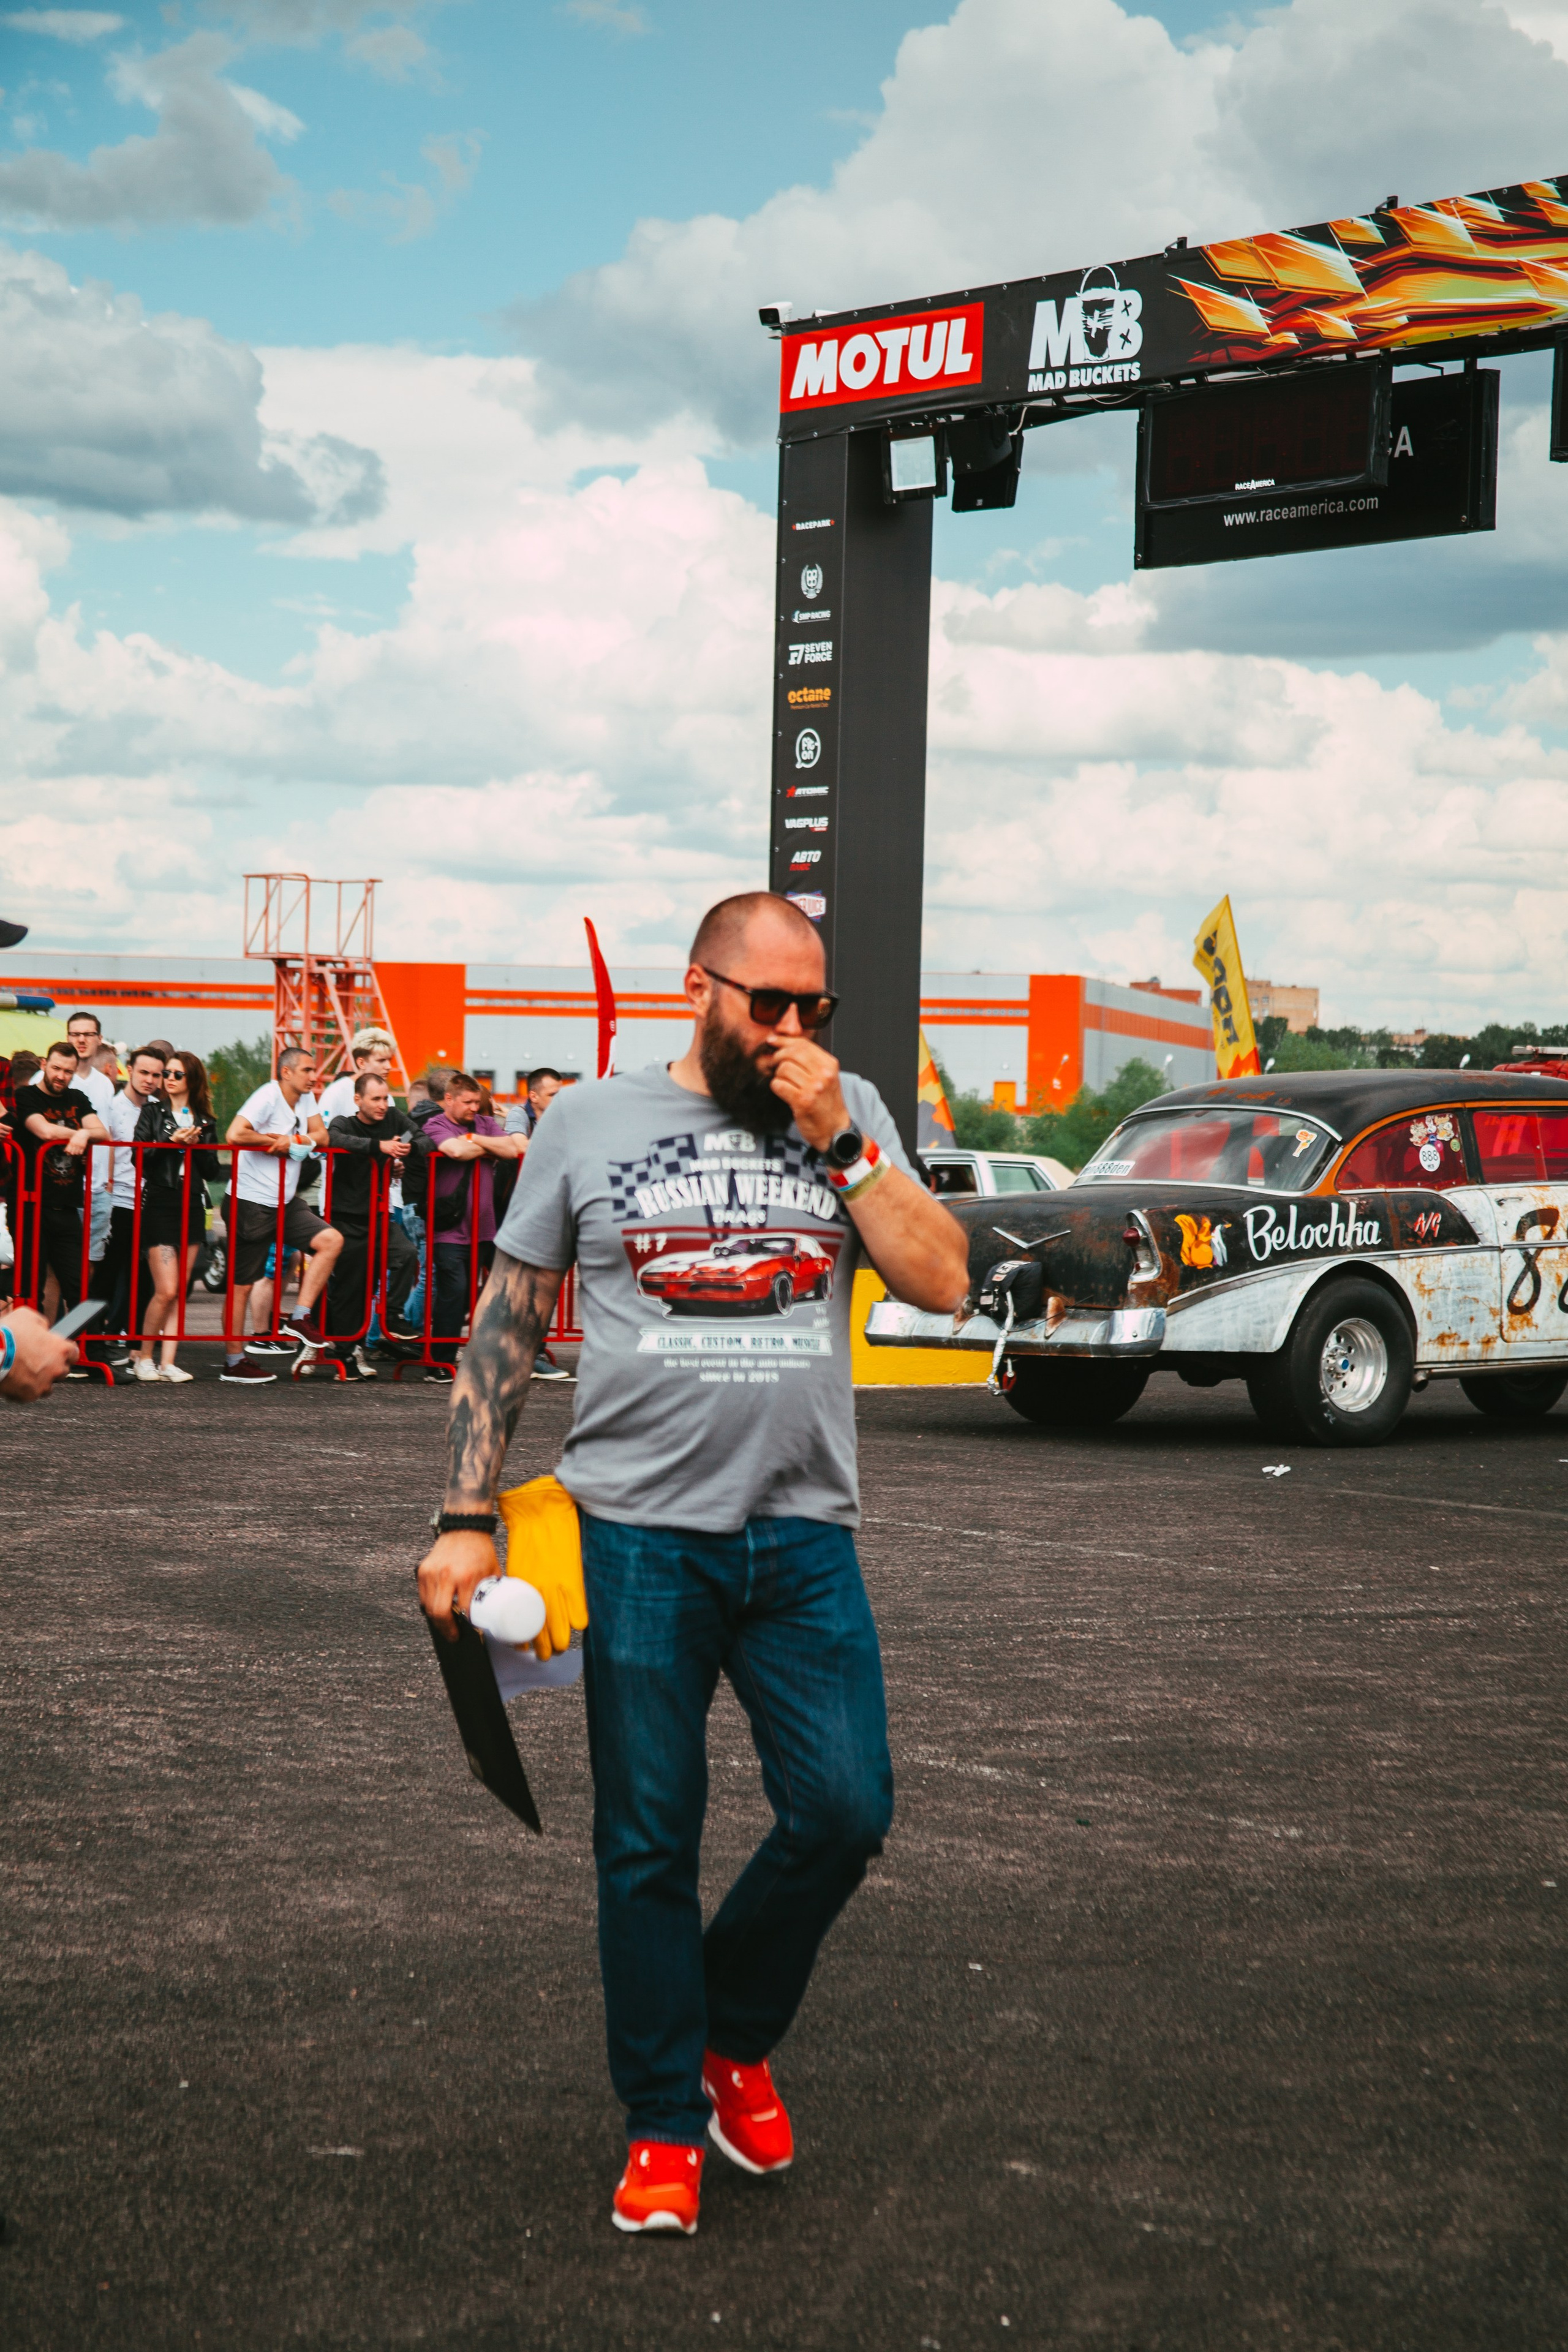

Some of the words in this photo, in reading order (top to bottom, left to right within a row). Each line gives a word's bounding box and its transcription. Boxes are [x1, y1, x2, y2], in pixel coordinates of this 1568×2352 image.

[790, 317, 973, 399] MOTUL
[1028, 370, 1066, 393] MAD
[1069, 362, 1141, 387] BUCKETS
[1224, 497, 1379, 527] www.raceamerica.com
[796, 519, 831, 530] RACEPARK
[805, 641, 832, 653] SEVEN
[804, 651, 832, 663] FORCE
[788, 687, 832, 704] octane
[689, 1158, 720, 1172] MAD
[722, 1157, 783, 1172] BUCKETS
[1422, 1150, 1439, 1162] 888
[635, 1174, 729, 1219] RUSSIAN
[734, 1174, 837, 1221] WEEKEND
[712, 1209, 767, 1226] DRAGS
[1243, 1202, 1382, 1261] Belochka
